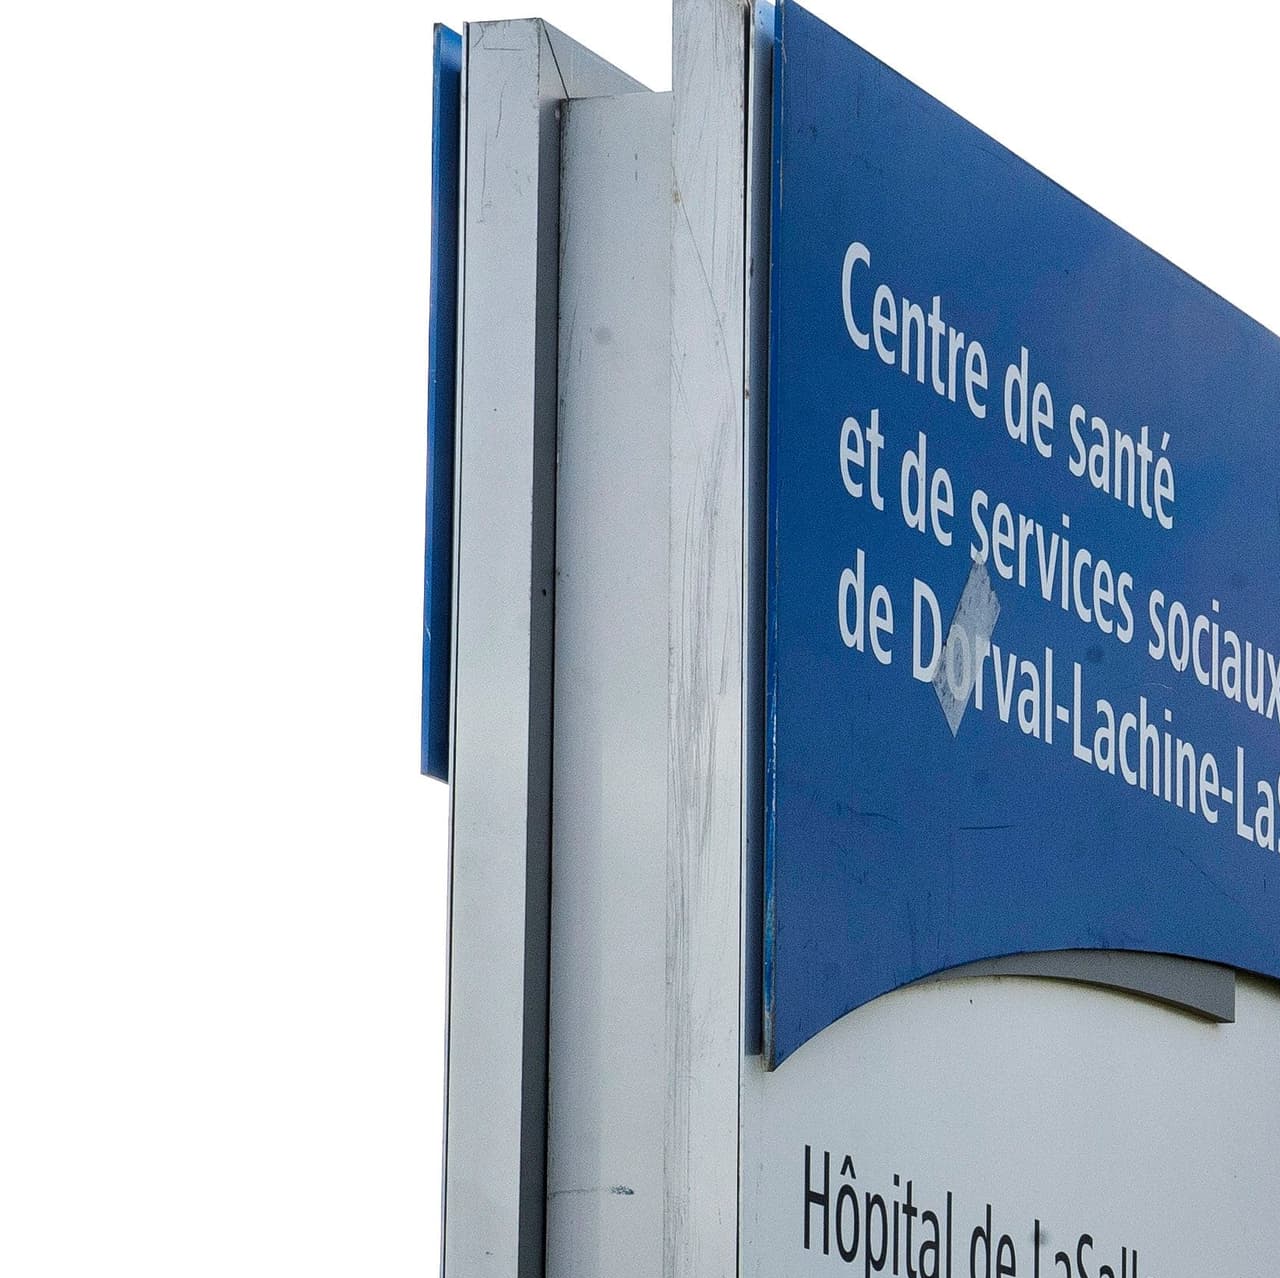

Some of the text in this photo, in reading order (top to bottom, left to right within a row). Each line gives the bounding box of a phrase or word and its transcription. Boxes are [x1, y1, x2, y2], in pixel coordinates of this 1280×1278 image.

[841, 241, 1175, 529] Centre de santé
[838, 549, 893, 665] de
[839, 409, 884, 510] et
[901, 432, 954, 546] de
[970, 490, 1134, 643] services
